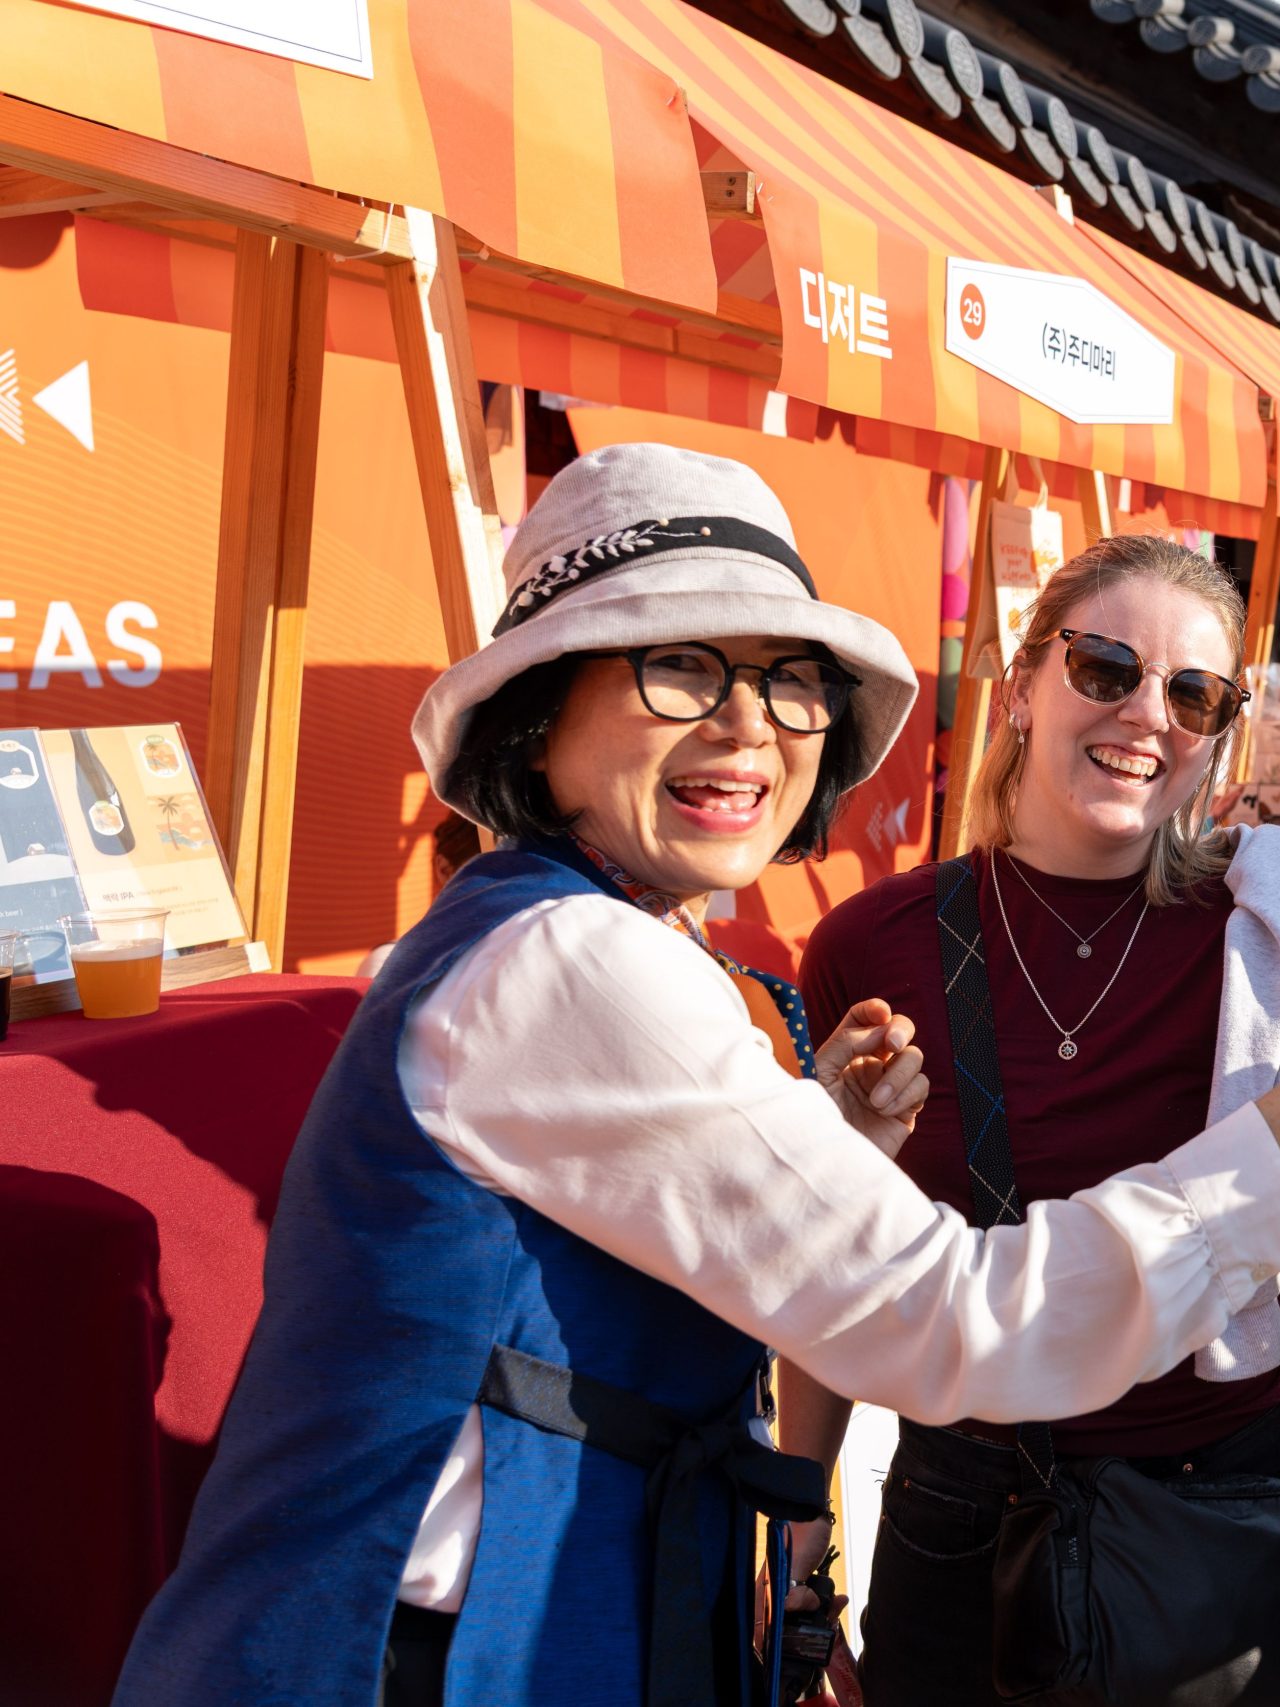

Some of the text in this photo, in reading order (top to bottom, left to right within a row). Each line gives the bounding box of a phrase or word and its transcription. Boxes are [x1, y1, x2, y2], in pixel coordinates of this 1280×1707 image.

[799, 267, 893, 360] 디저트
[963, 298, 983, 327] 29
[1042, 322, 1116, 381] (주)주디마리
